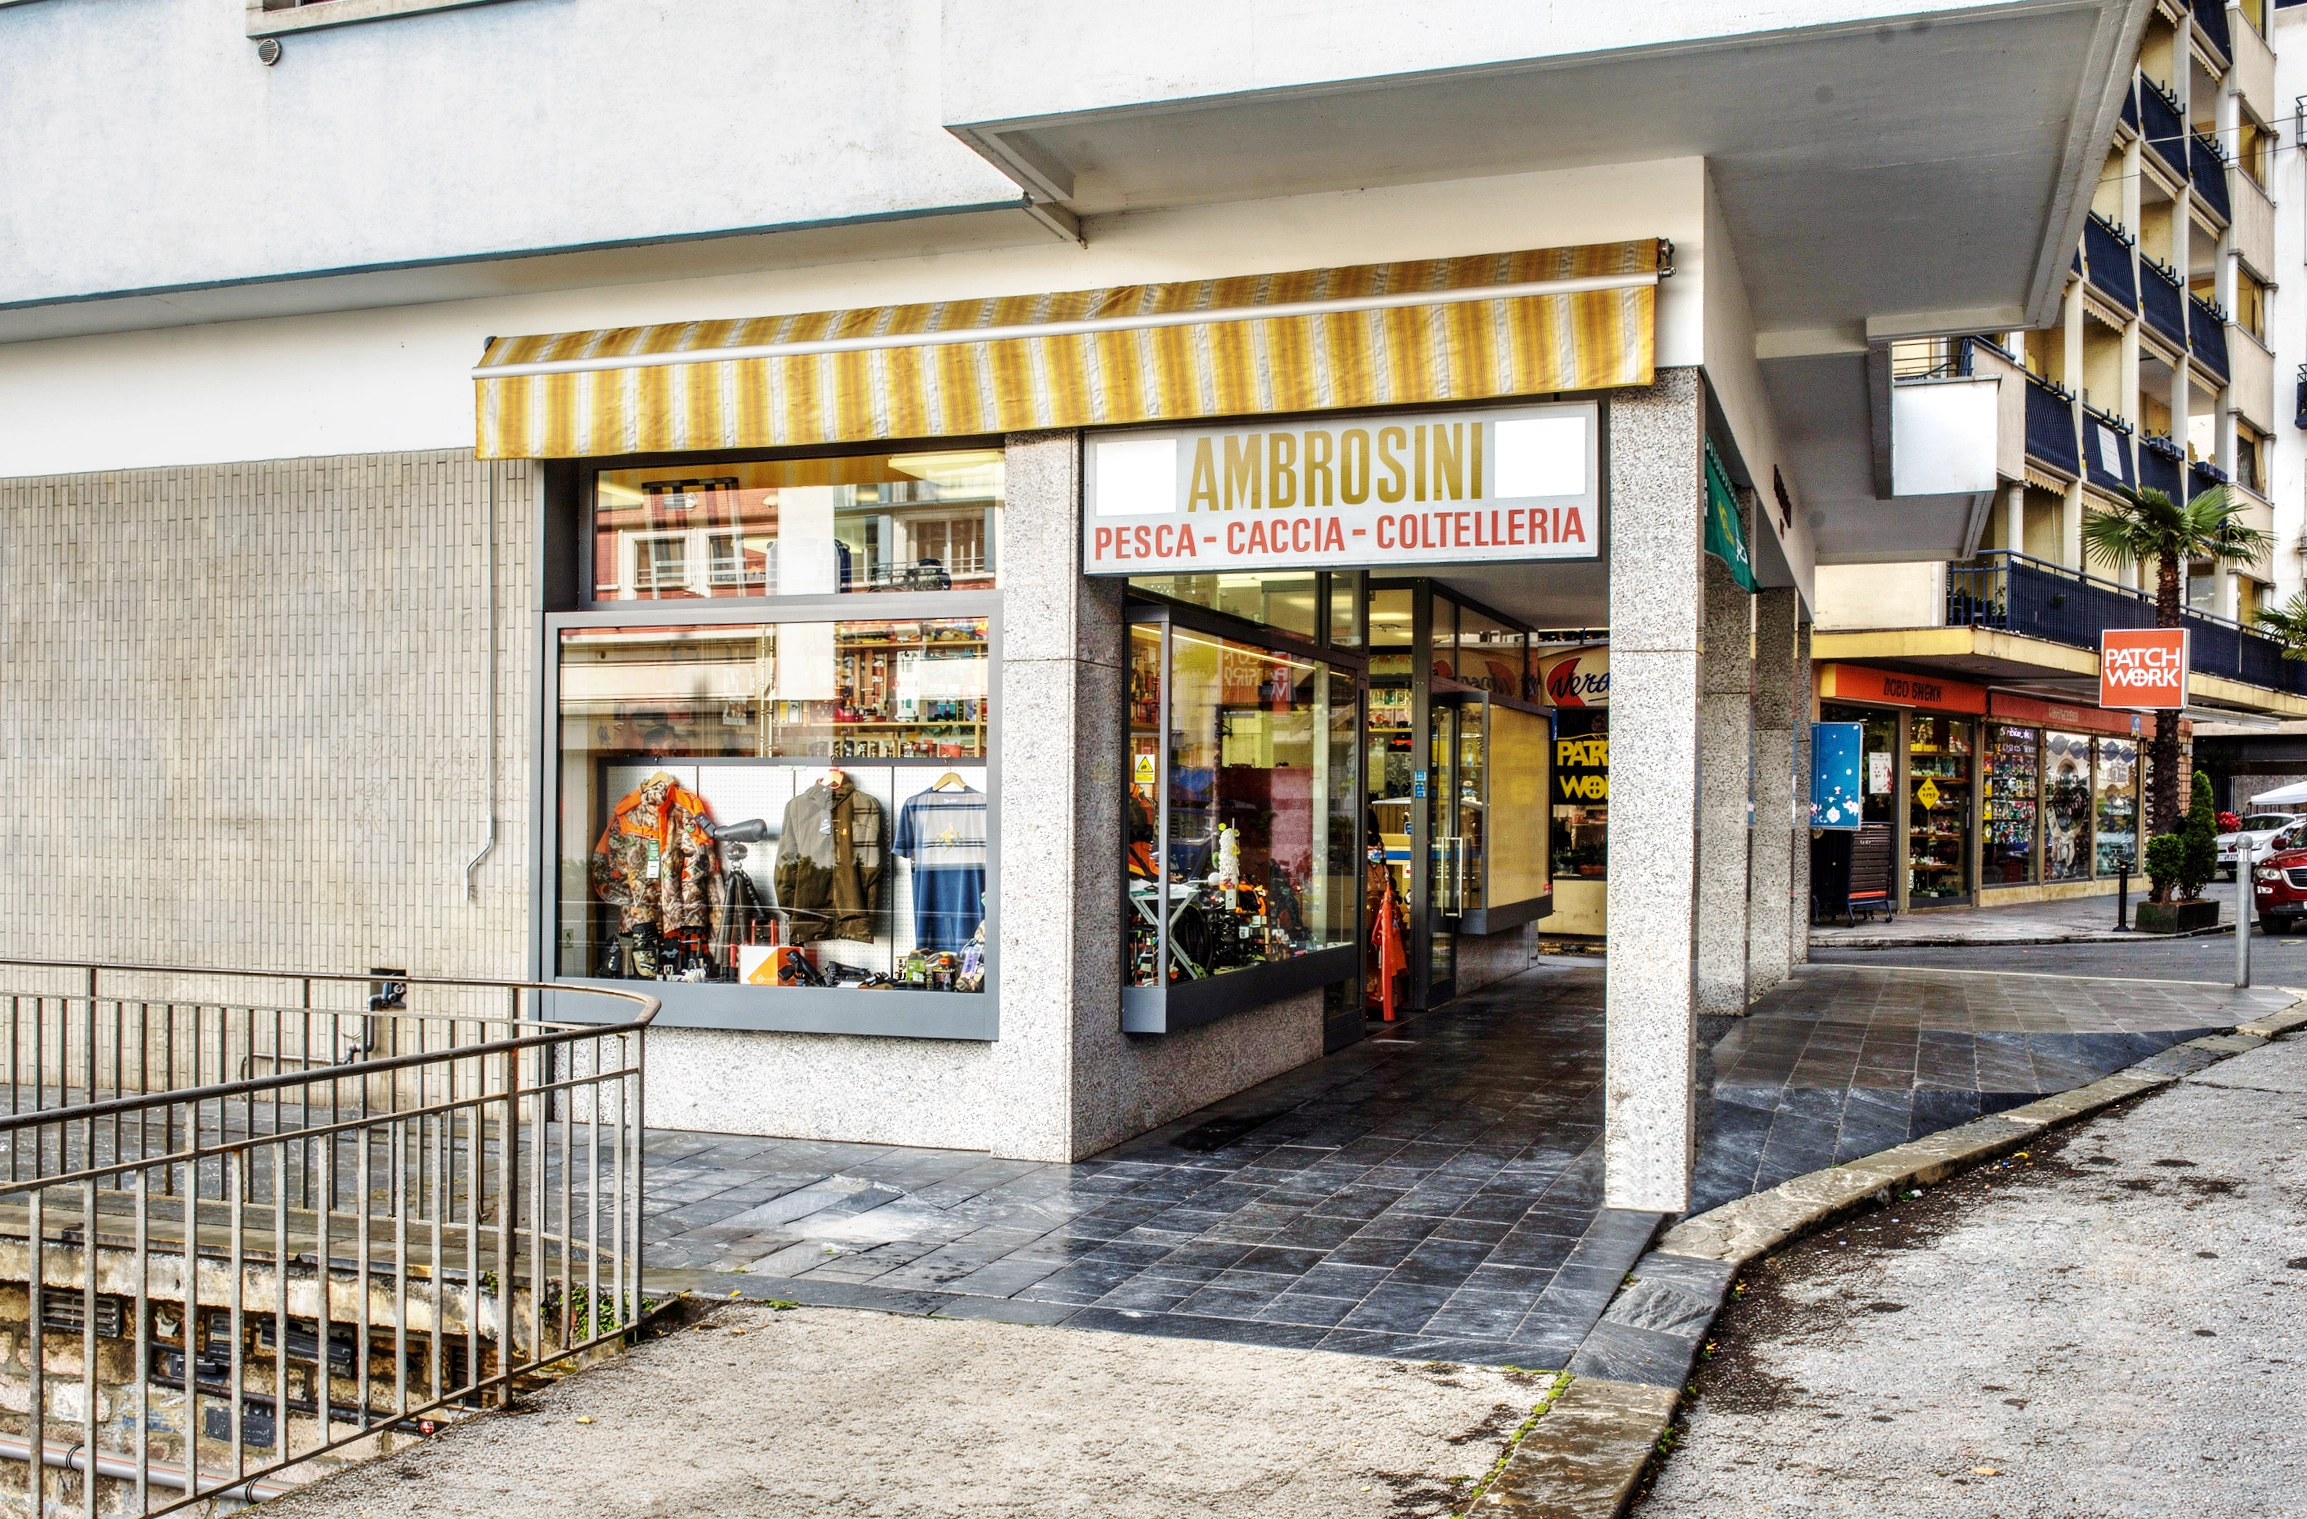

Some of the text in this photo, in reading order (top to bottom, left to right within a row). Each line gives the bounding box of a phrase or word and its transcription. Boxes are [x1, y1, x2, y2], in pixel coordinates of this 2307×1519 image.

[1188, 422, 1482, 512] AMBROSINI
[1095, 524, 1197, 560] PESCA
[1227, 517, 1345, 554] CACCIA
[1376, 507, 1586, 549] COLTELLERIA
[2105, 647, 2181, 668] PATCH
[2105, 667, 2180, 687] WORK
[1559, 775, 1608, 800] WO
